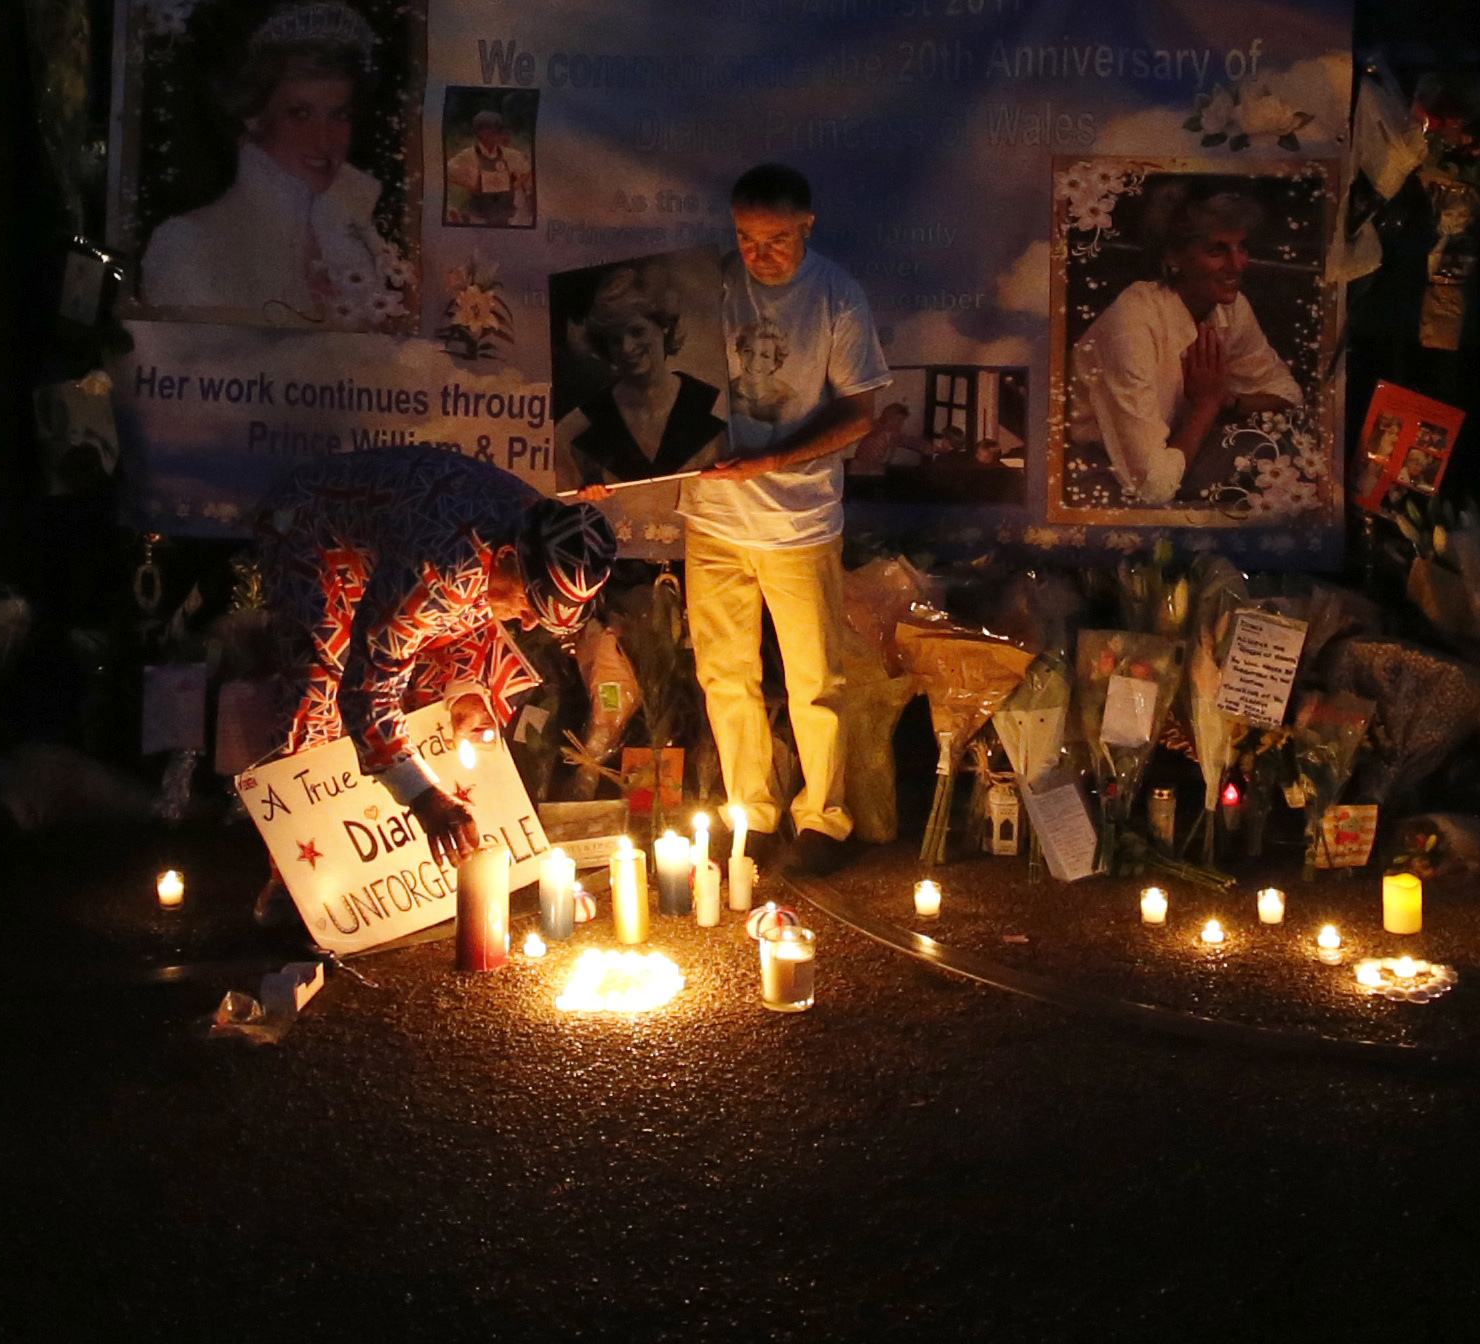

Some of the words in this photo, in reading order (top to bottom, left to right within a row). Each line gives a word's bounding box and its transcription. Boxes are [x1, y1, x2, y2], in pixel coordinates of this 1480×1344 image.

[477, 39, 536, 87] We
[898, 39, 972, 83] 20th
[985, 34, 1211, 87] Anniversary
[1224, 38, 1263, 79] of
[986, 102, 1097, 147] Wales
[876, 221, 958, 249] family
[134, 366, 190, 400] Her
[199, 371, 275, 406] work
[284, 377, 429, 417] continues
[248, 420, 342, 455] Prince
[475, 434, 495, 463] &
[260, 783, 292, 822] A
[292, 768, 358, 806] True
